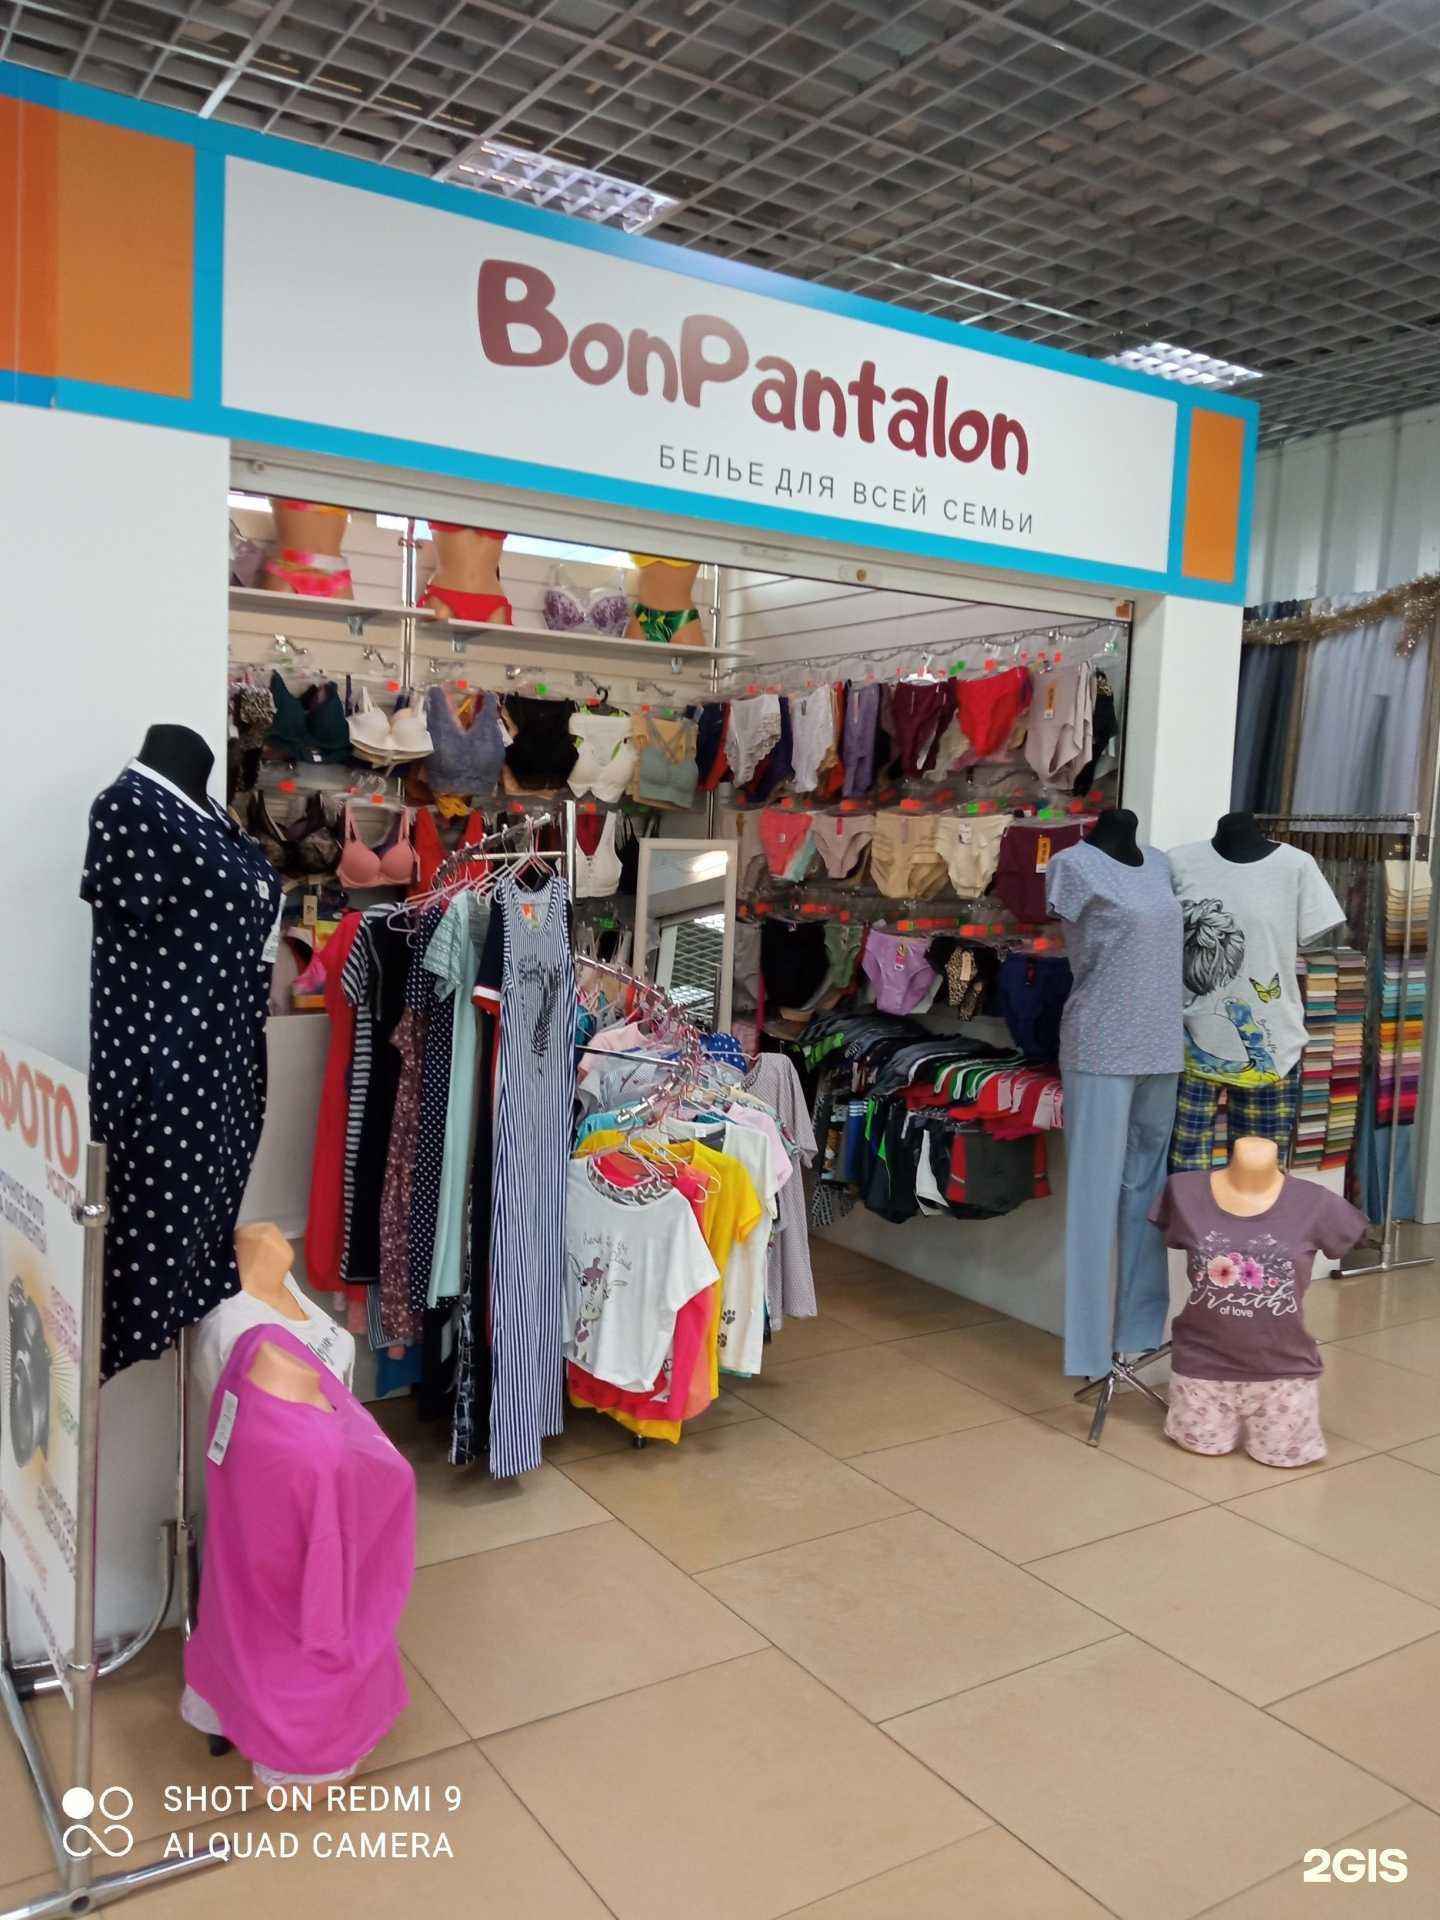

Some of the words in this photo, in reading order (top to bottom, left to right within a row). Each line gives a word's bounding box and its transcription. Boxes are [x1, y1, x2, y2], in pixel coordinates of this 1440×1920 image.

[477, 258, 1030, 475] BonPantalon
[659, 444, 764, 486] БЕЛЬЕ
[775, 467, 834, 499] ДЛЯ
[852, 480, 927, 516] ВСЕЙ
[943, 498, 1033, 534] СЕМЬИ
[1220, 1305, 1231, 1316] of
[1232, 1306, 1254, 1318] love
